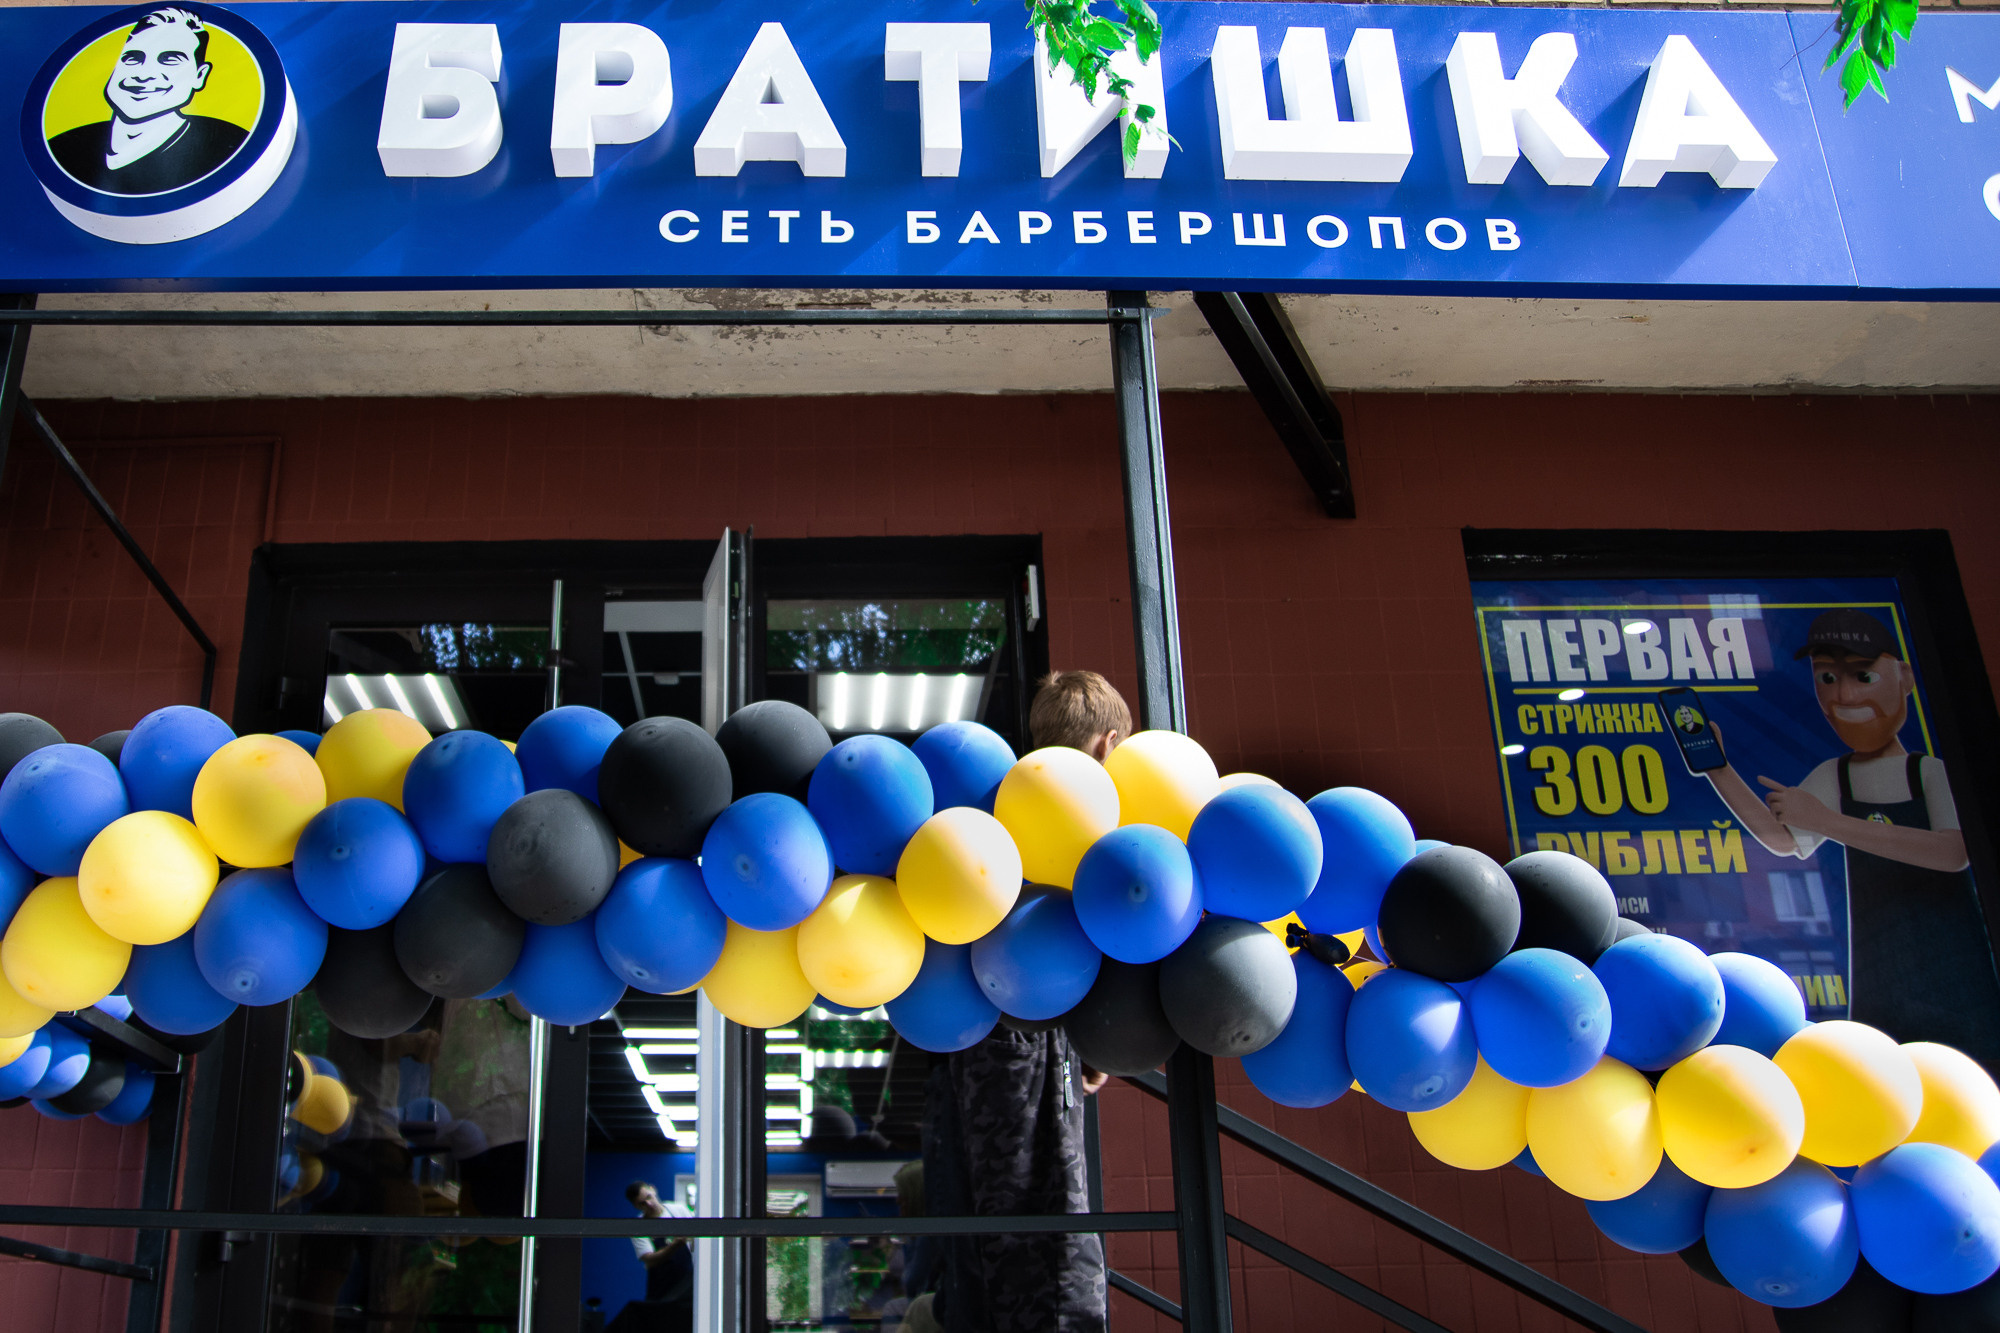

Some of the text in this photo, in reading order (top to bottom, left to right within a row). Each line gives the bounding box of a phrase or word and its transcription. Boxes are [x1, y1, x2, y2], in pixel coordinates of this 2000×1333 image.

[377, 22, 1778, 190] БРАТИШКА
[658, 209, 1522, 252] СЕТЬ БАРБЕРШОПОВ
[1501, 617, 1756, 682] ПЕРВАЯ
[1517, 703, 1664, 735] СТРИЖКА
[1528, 744, 1669, 817] 300
